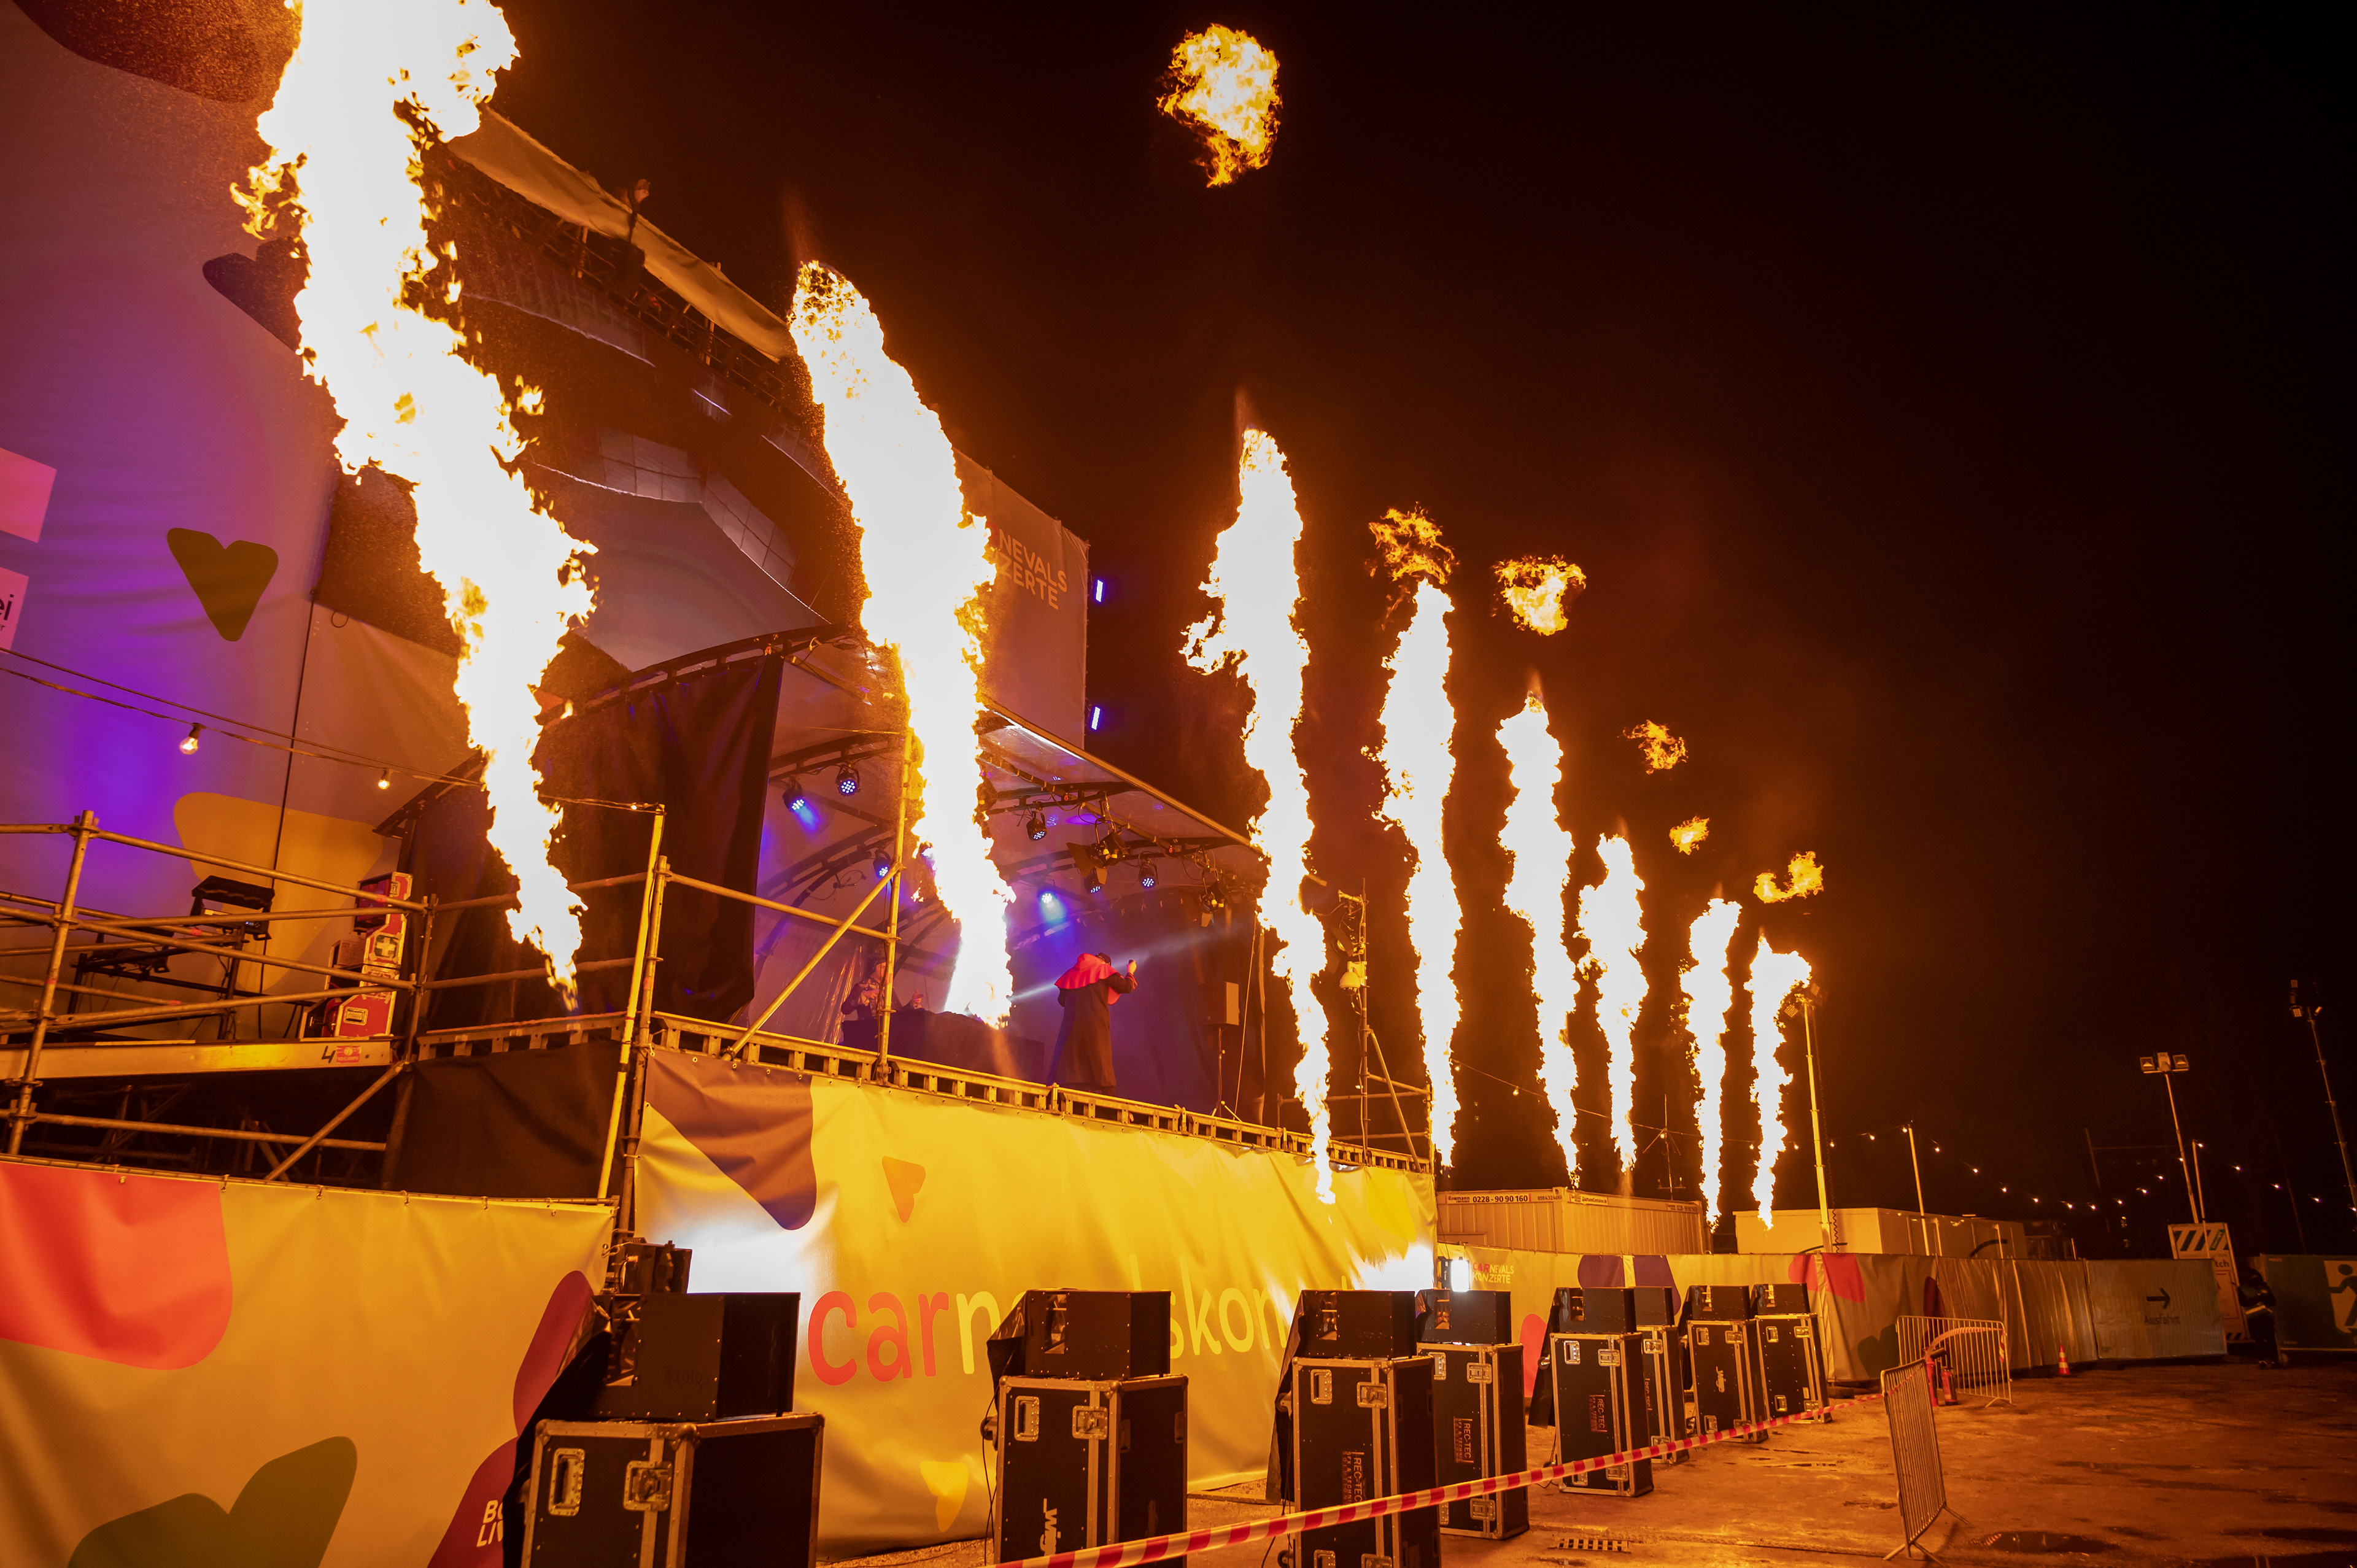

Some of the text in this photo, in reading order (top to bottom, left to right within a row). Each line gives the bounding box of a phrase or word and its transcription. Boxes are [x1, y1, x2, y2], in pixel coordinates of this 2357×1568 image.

[322, 1045, 336, 1064] 4
[1473, 1271, 1511, 1284] KONZERTE
[1353, 1458, 1362, 1502] REC-TEC
